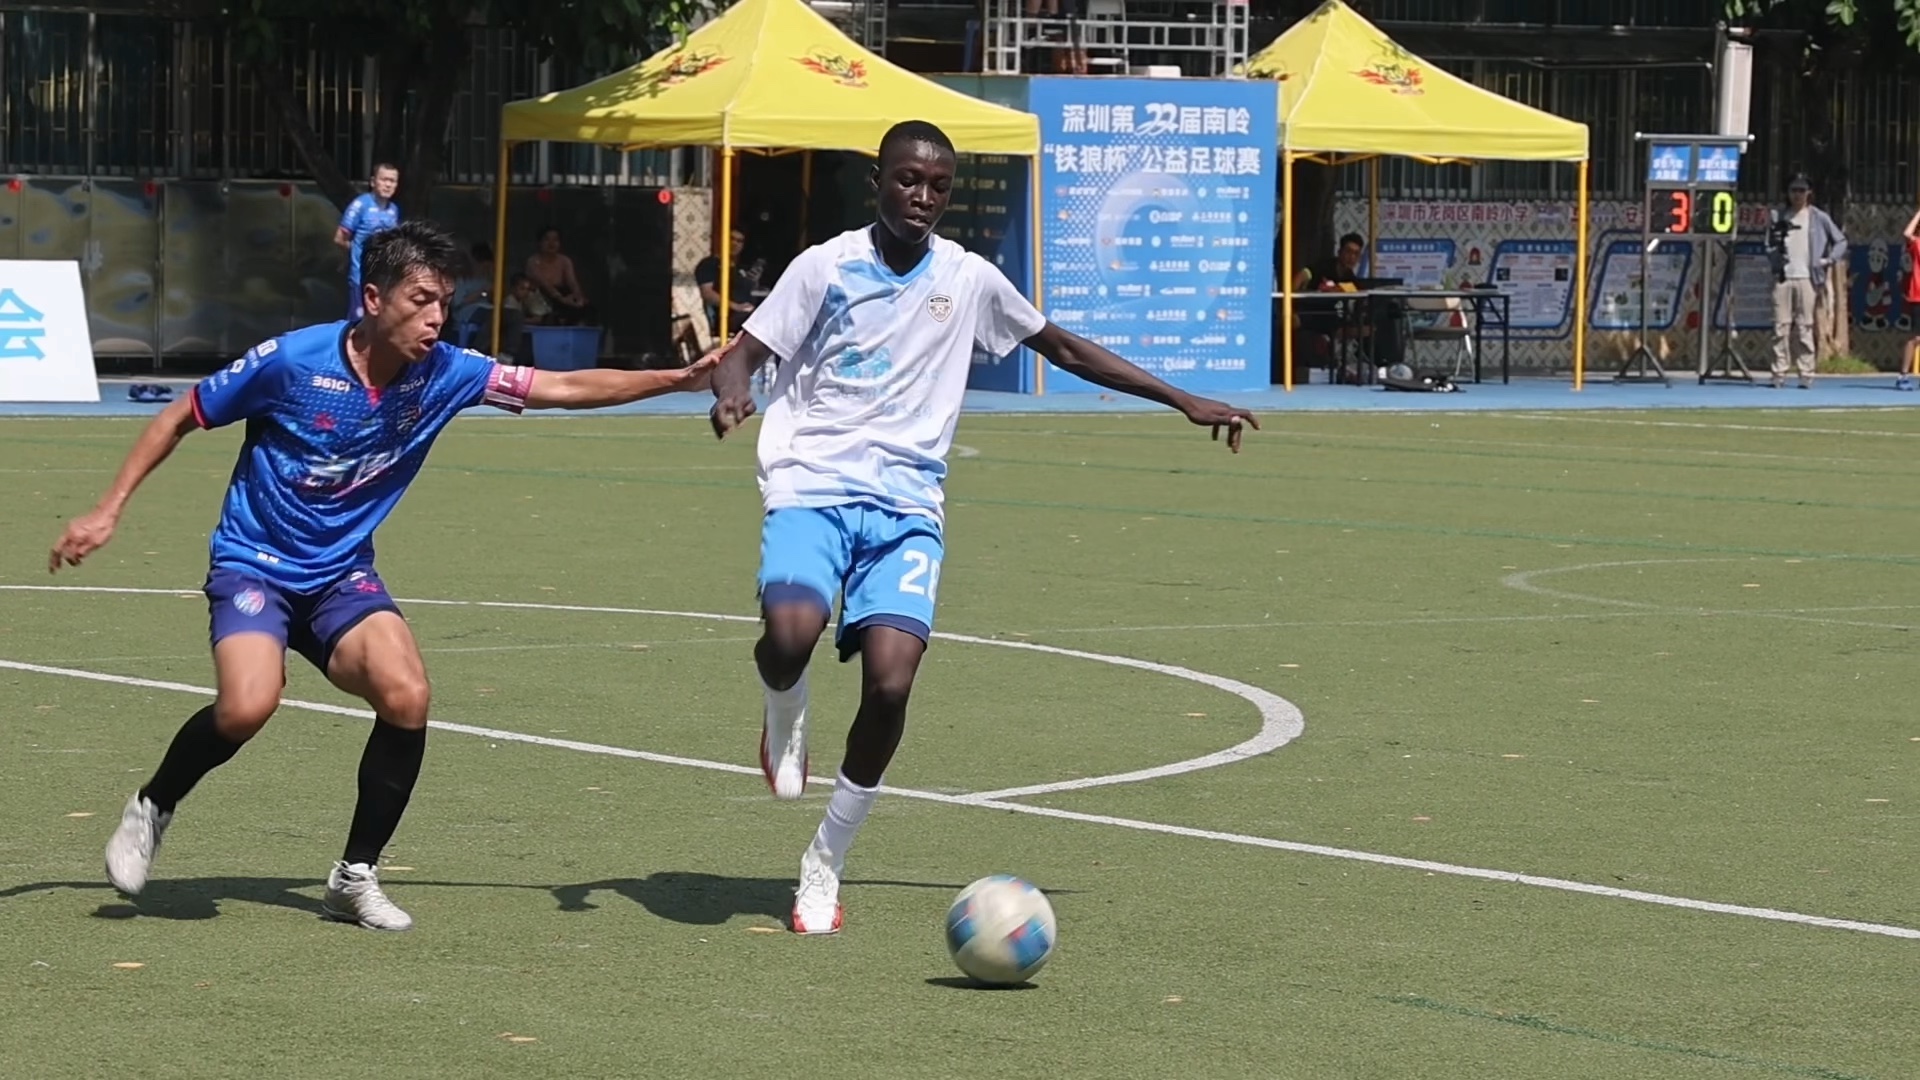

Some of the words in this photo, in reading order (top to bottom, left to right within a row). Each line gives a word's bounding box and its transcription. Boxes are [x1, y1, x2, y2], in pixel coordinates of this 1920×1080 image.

[1062, 103, 1250, 136] 深圳第22届南岭
[1383, 203, 1530, 223] 深圳市龙岗区南岭小学
[1671, 191, 1688, 232] 3
[1712, 191, 1733, 233] 0
